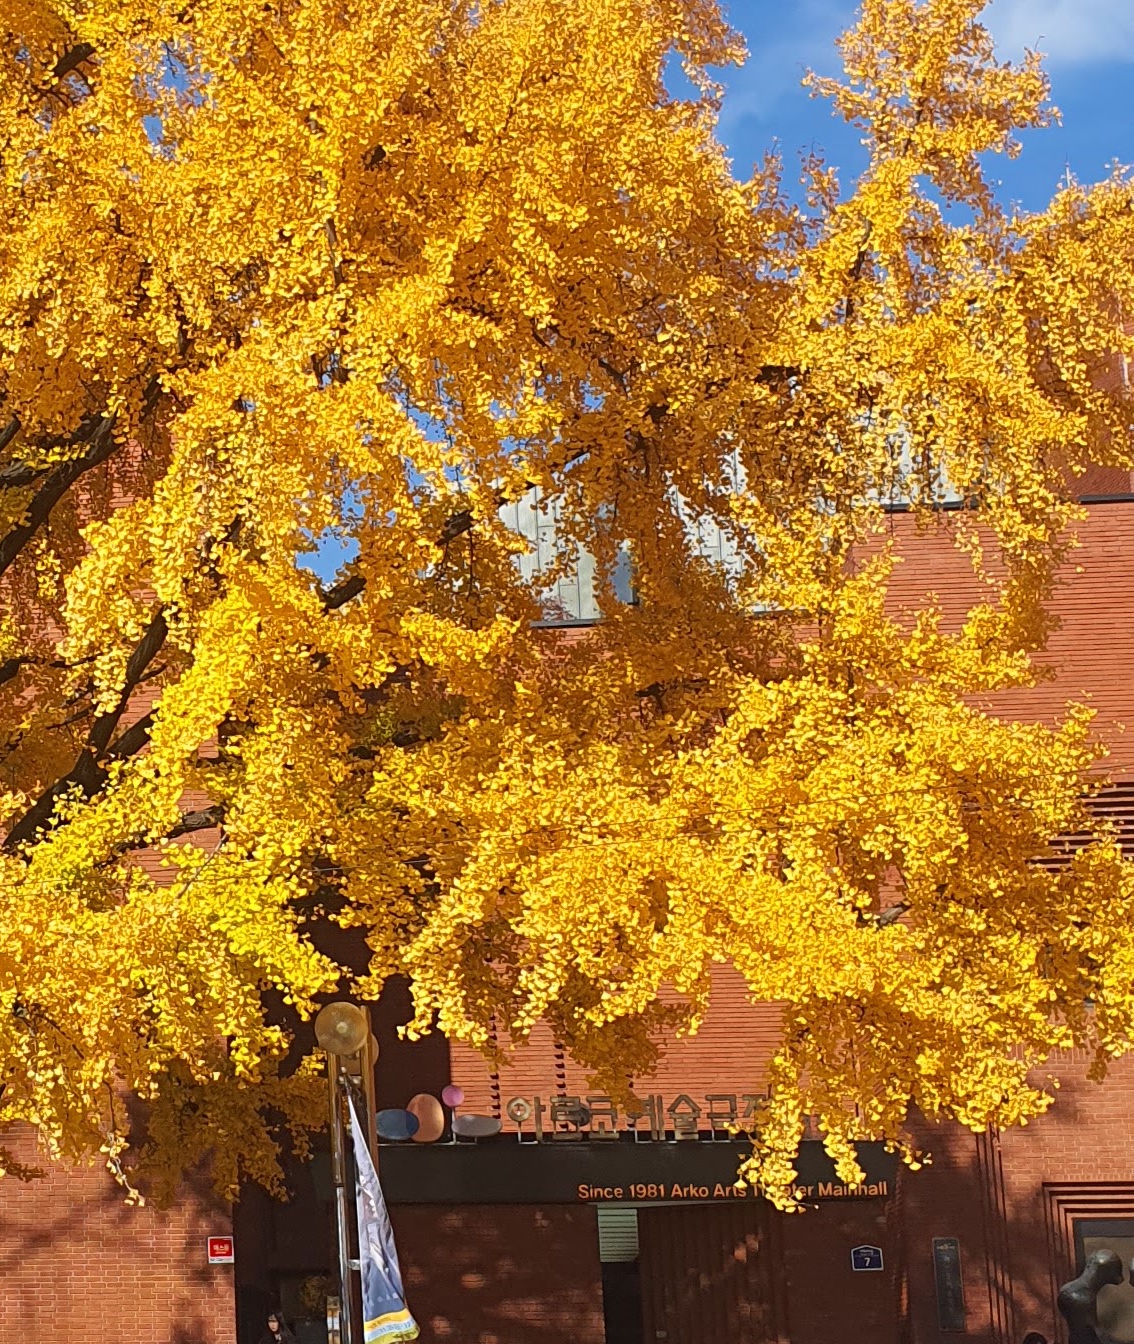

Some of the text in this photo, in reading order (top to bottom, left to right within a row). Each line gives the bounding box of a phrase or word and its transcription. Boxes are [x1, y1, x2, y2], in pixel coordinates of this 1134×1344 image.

[577, 1183, 624, 1200] Since
[629, 1183, 665, 1199] 1981
[671, 1182, 709, 1198] Arko
[713, 1182, 747, 1198] Arts
[864, 1257, 871, 1267] 7
